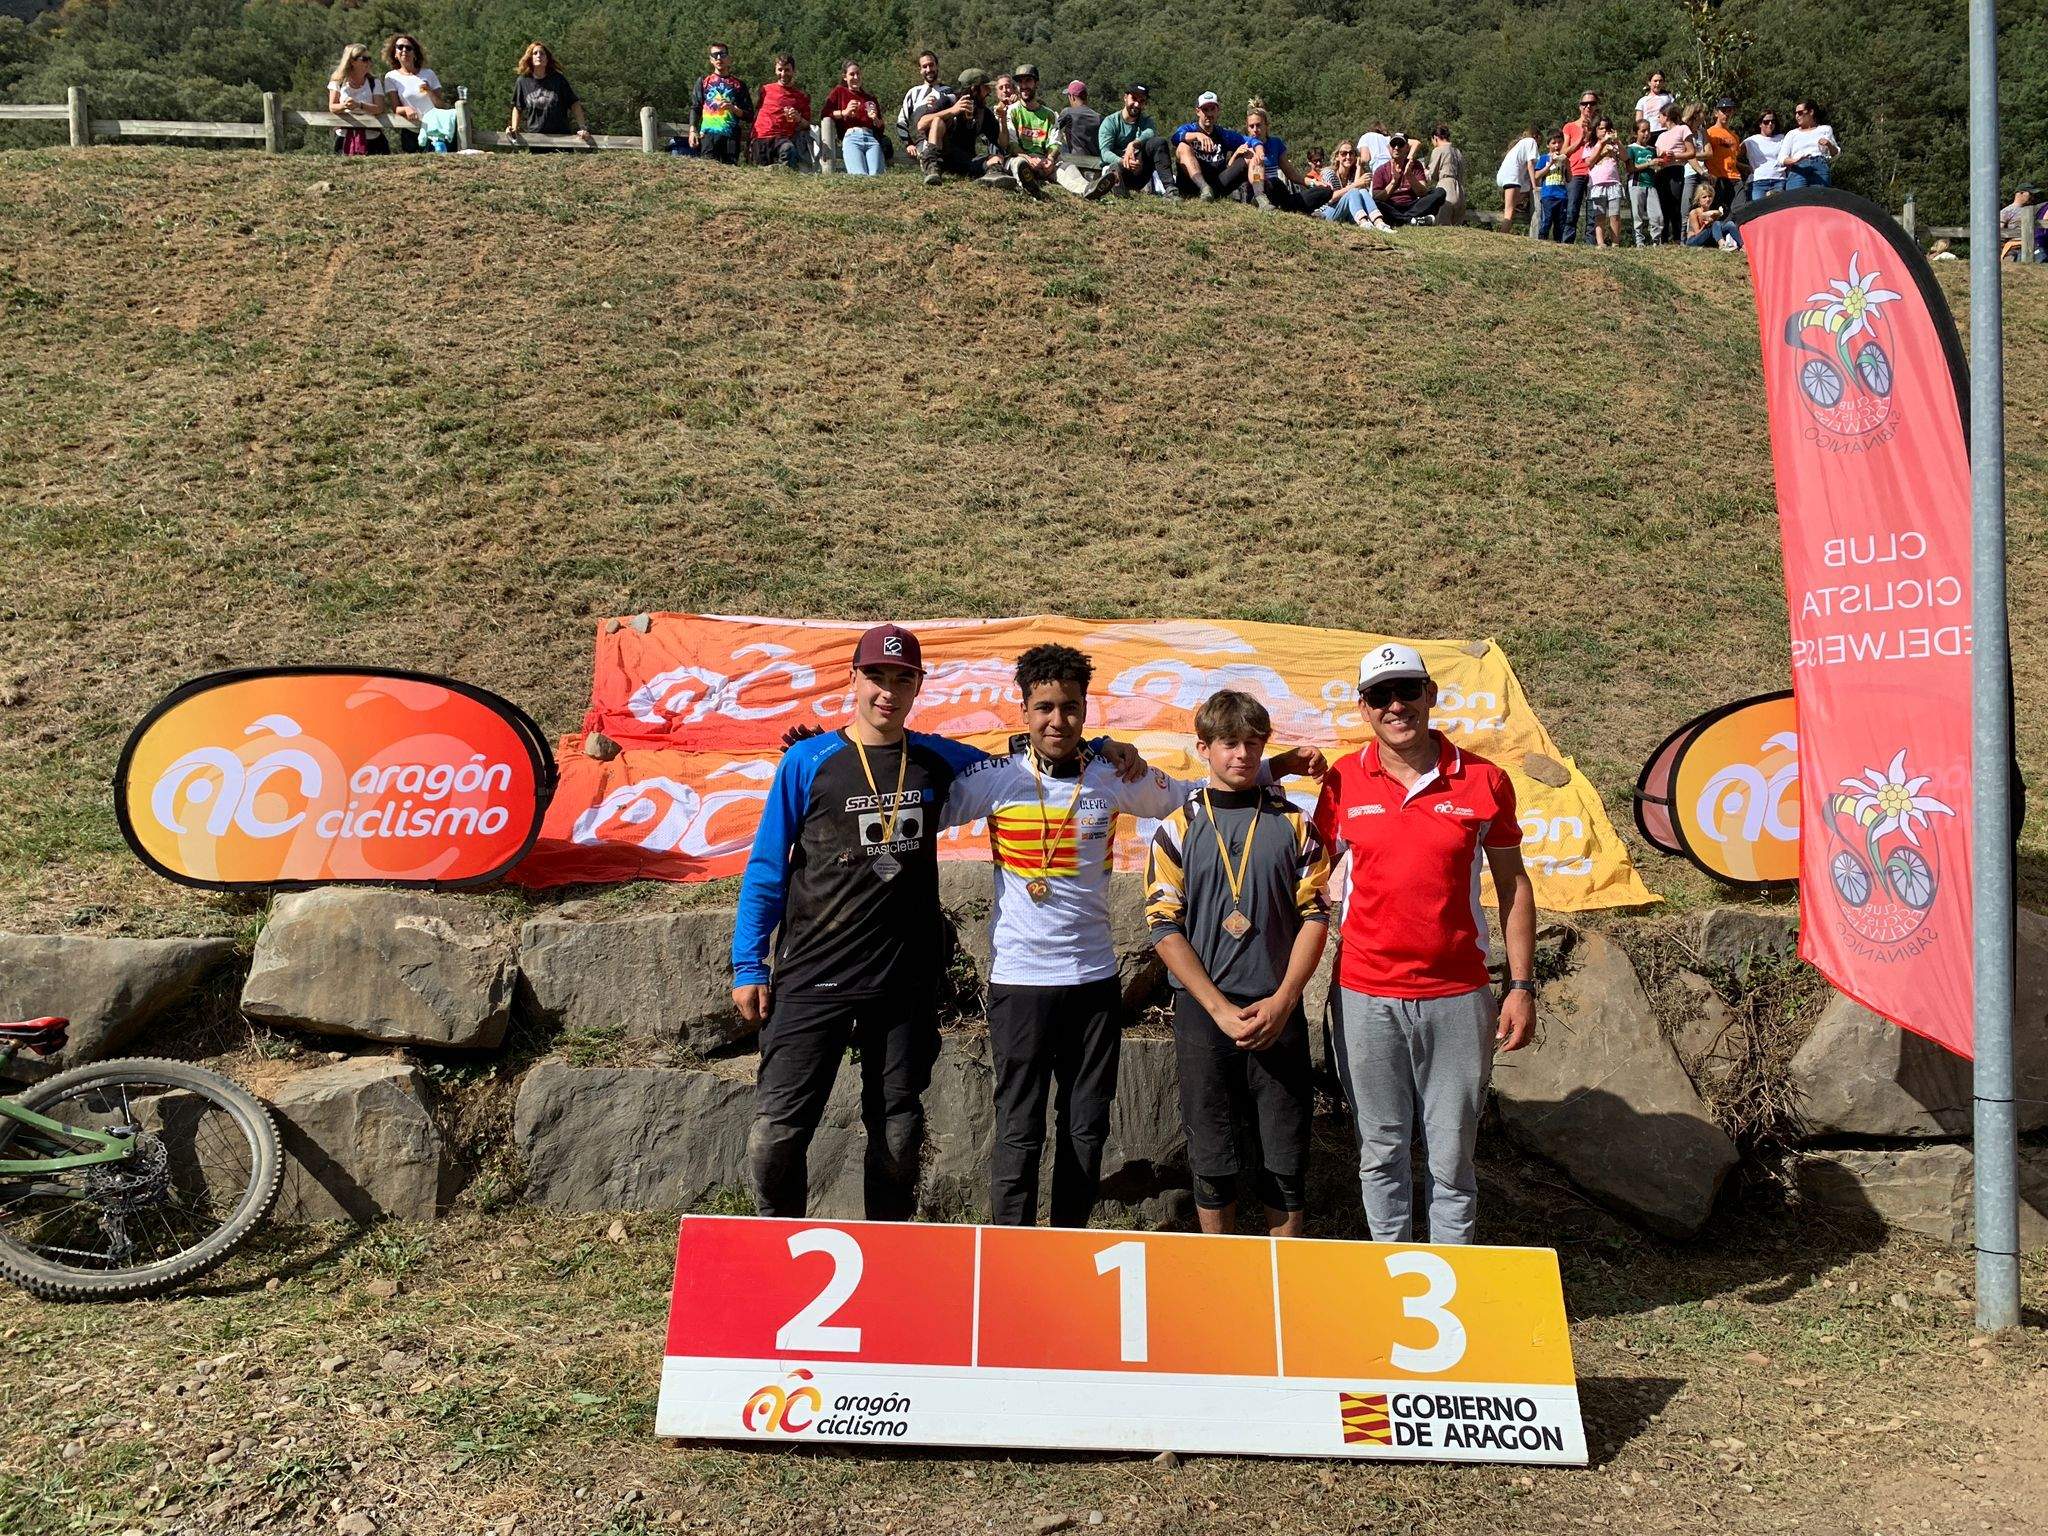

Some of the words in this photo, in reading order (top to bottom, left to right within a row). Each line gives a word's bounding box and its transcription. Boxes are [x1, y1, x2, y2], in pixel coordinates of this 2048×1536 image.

[350, 753, 512, 801] aragón
[869, 790, 921, 808] SNTOUR
[316, 800, 508, 839] ciclismo
[774, 1227, 865, 1354] 2
[1093, 1241, 1148, 1363] 1
[1383, 1250, 1468, 1374] 3
[833, 1391, 911, 1420] aragón
[1391, 1393, 1538, 1423] GOBIERNO
[816, 1415, 909, 1438] ciclismo
[1394, 1422, 1432, 1448] DE
[1443, 1424, 1565, 1452] ARAGON
